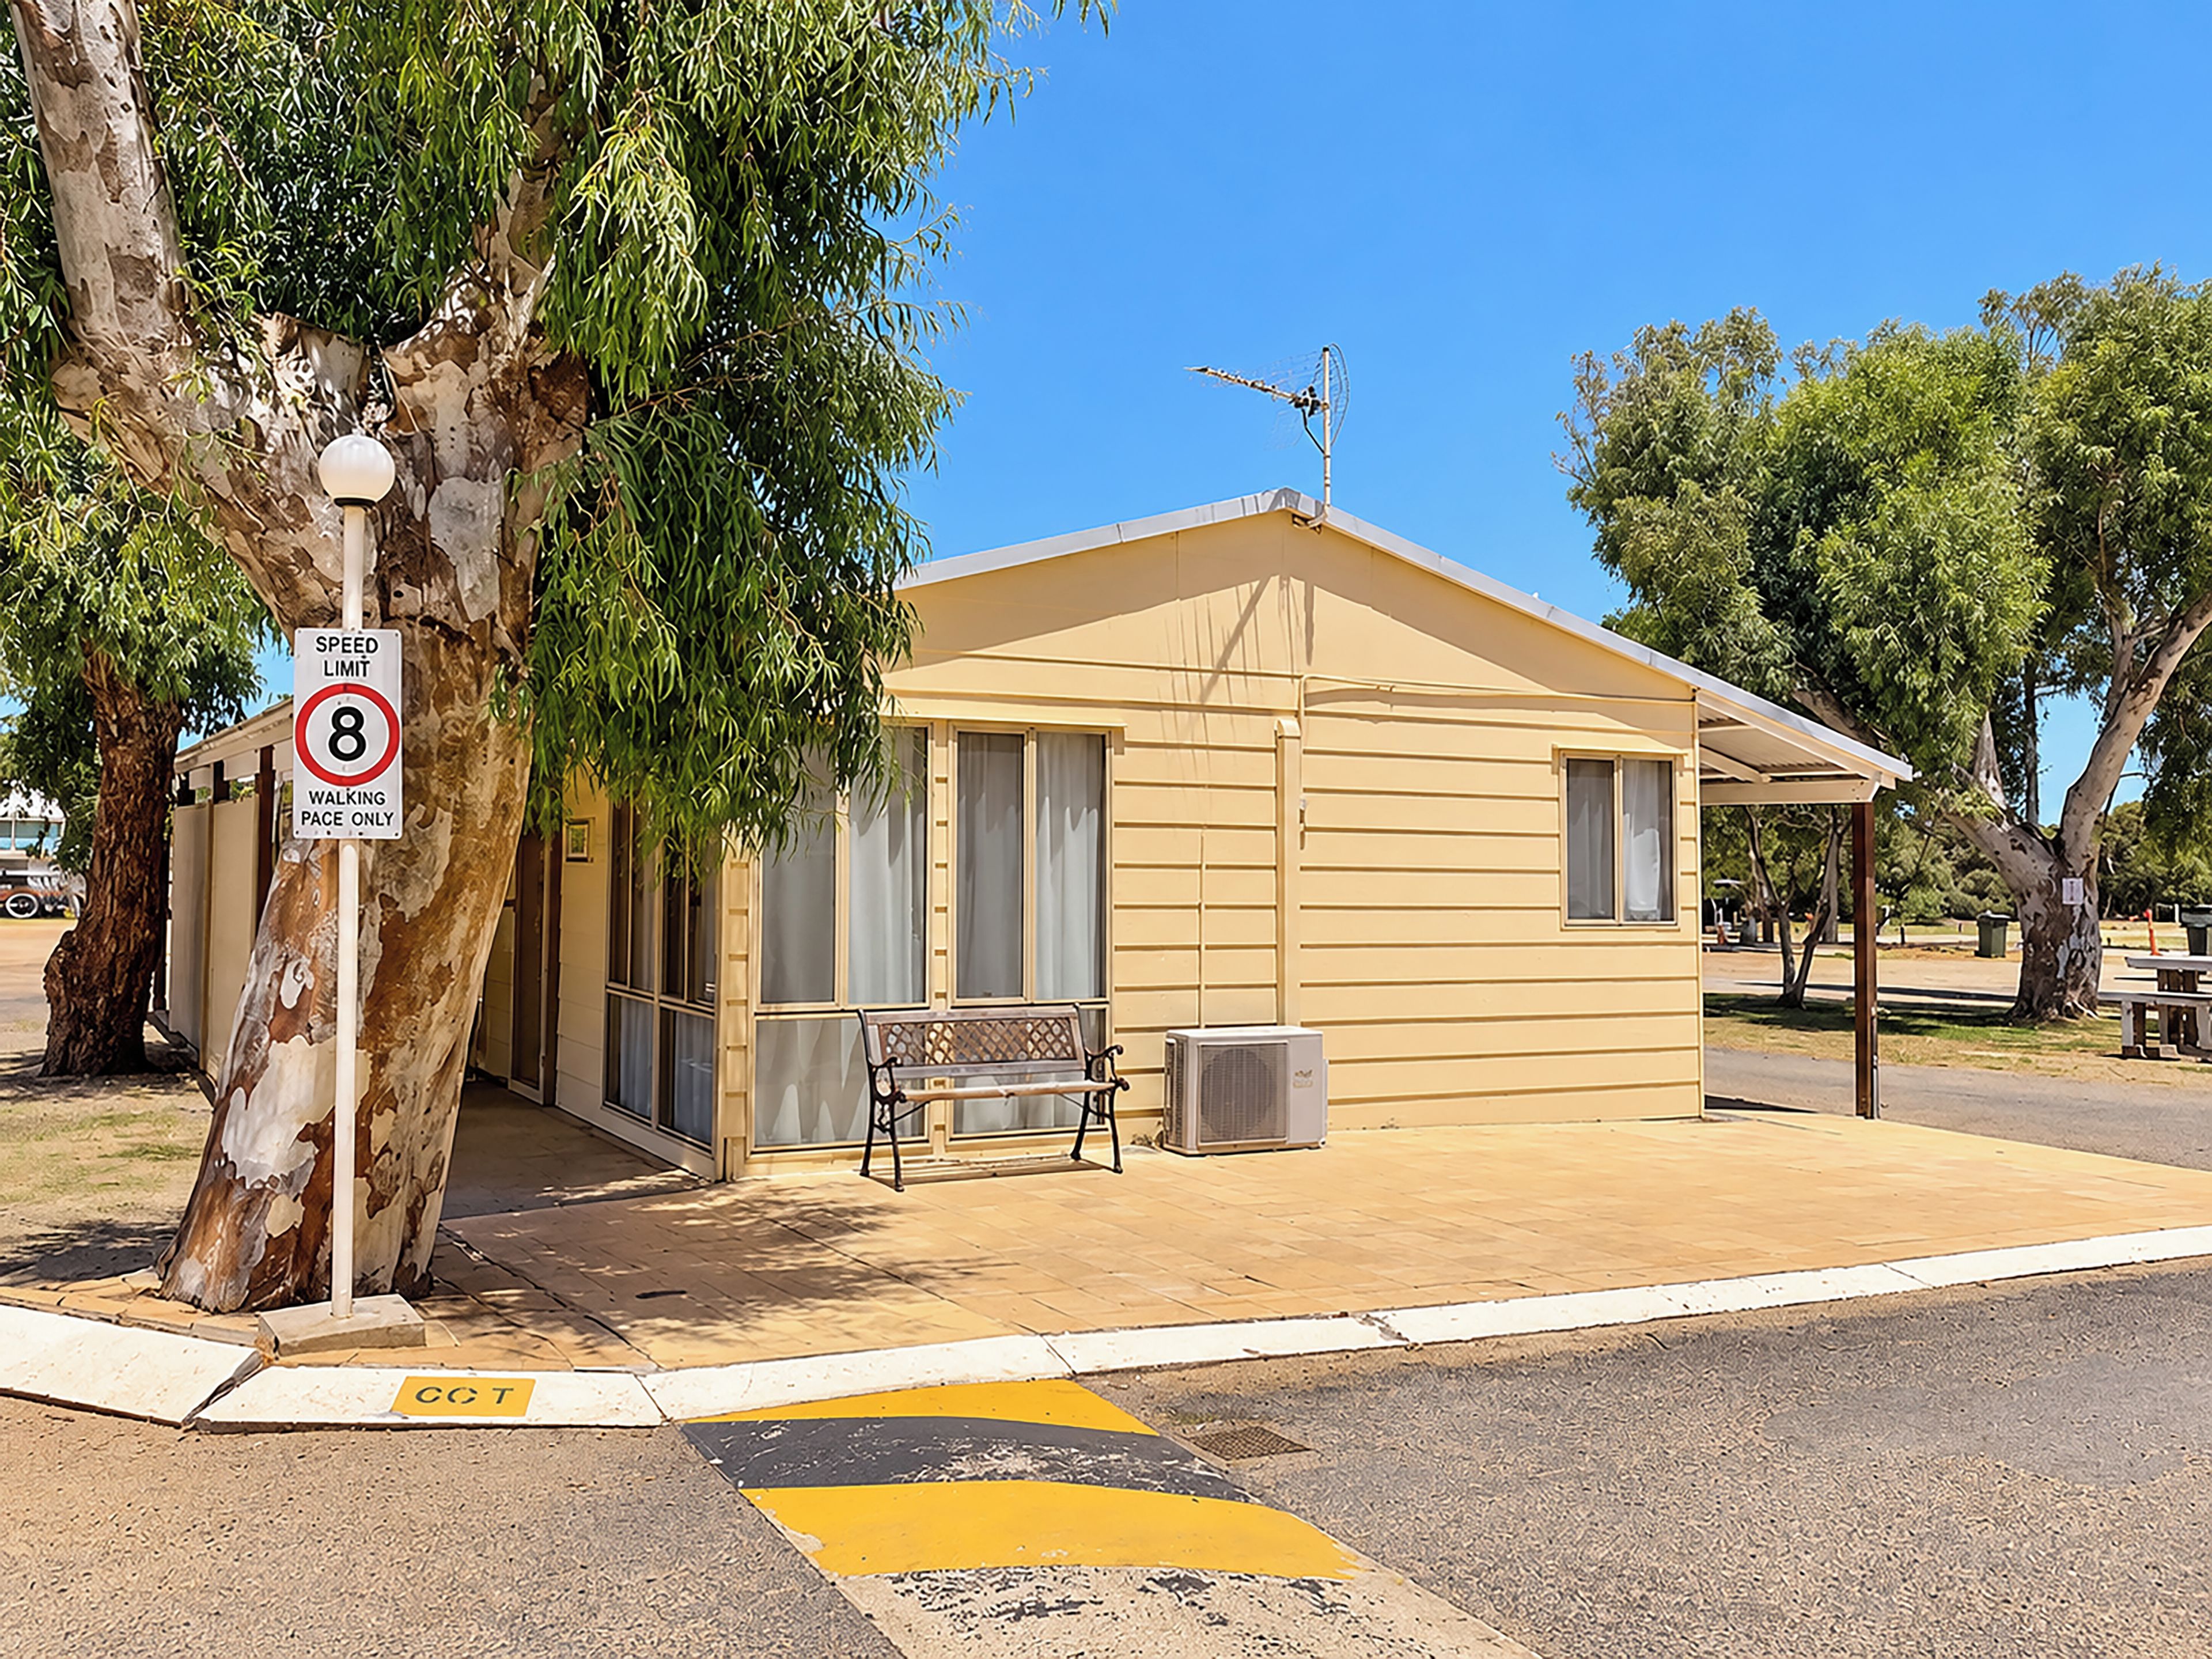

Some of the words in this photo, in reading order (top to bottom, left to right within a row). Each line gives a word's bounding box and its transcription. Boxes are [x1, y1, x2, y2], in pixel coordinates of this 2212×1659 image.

[316, 636, 378, 654] SPEED
[324, 660, 370, 677] LIMIT
[328, 706, 366, 762] 8
[309, 791, 385, 805] WALKING
[301, 811, 343, 826] PACE
[351, 812, 394, 826] ONLY
